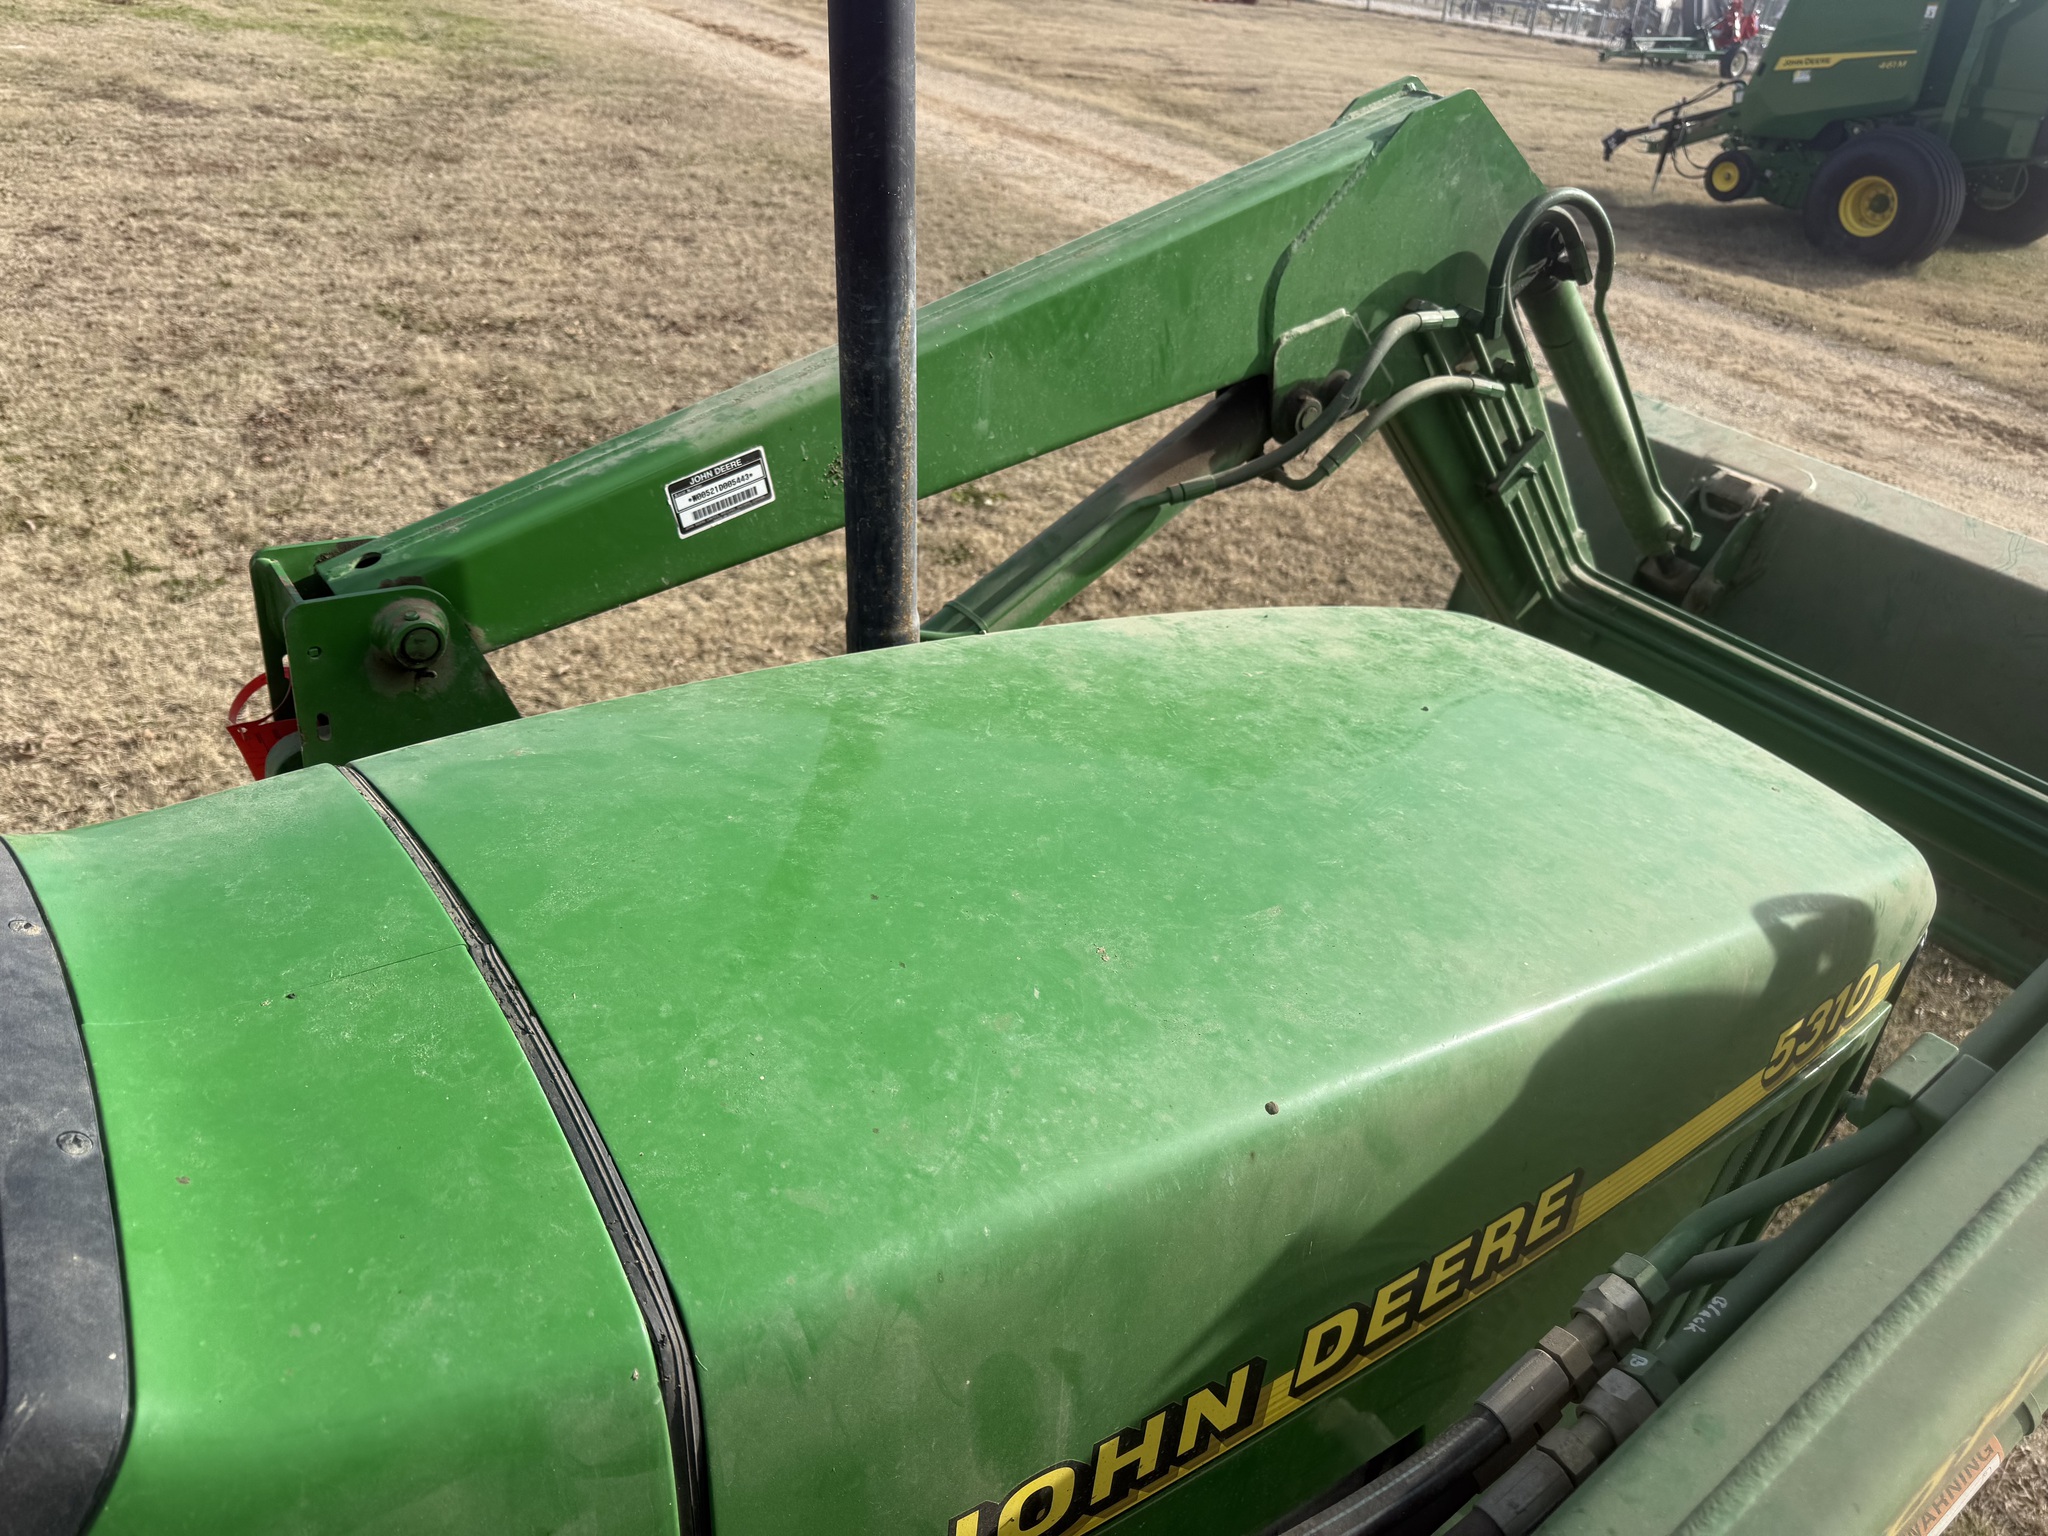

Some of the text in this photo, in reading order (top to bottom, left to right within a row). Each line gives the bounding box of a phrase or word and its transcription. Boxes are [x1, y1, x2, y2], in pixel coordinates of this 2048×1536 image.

[1804, 57, 1831, 66] DEERE
[689, 458, 742, 485] JOHN DEERE
[1762, 961, 1880, 1085] 5310
[1293, 1170, 1578, 1392] DEERE
[1683, 1296, 1728, 1333] Black
